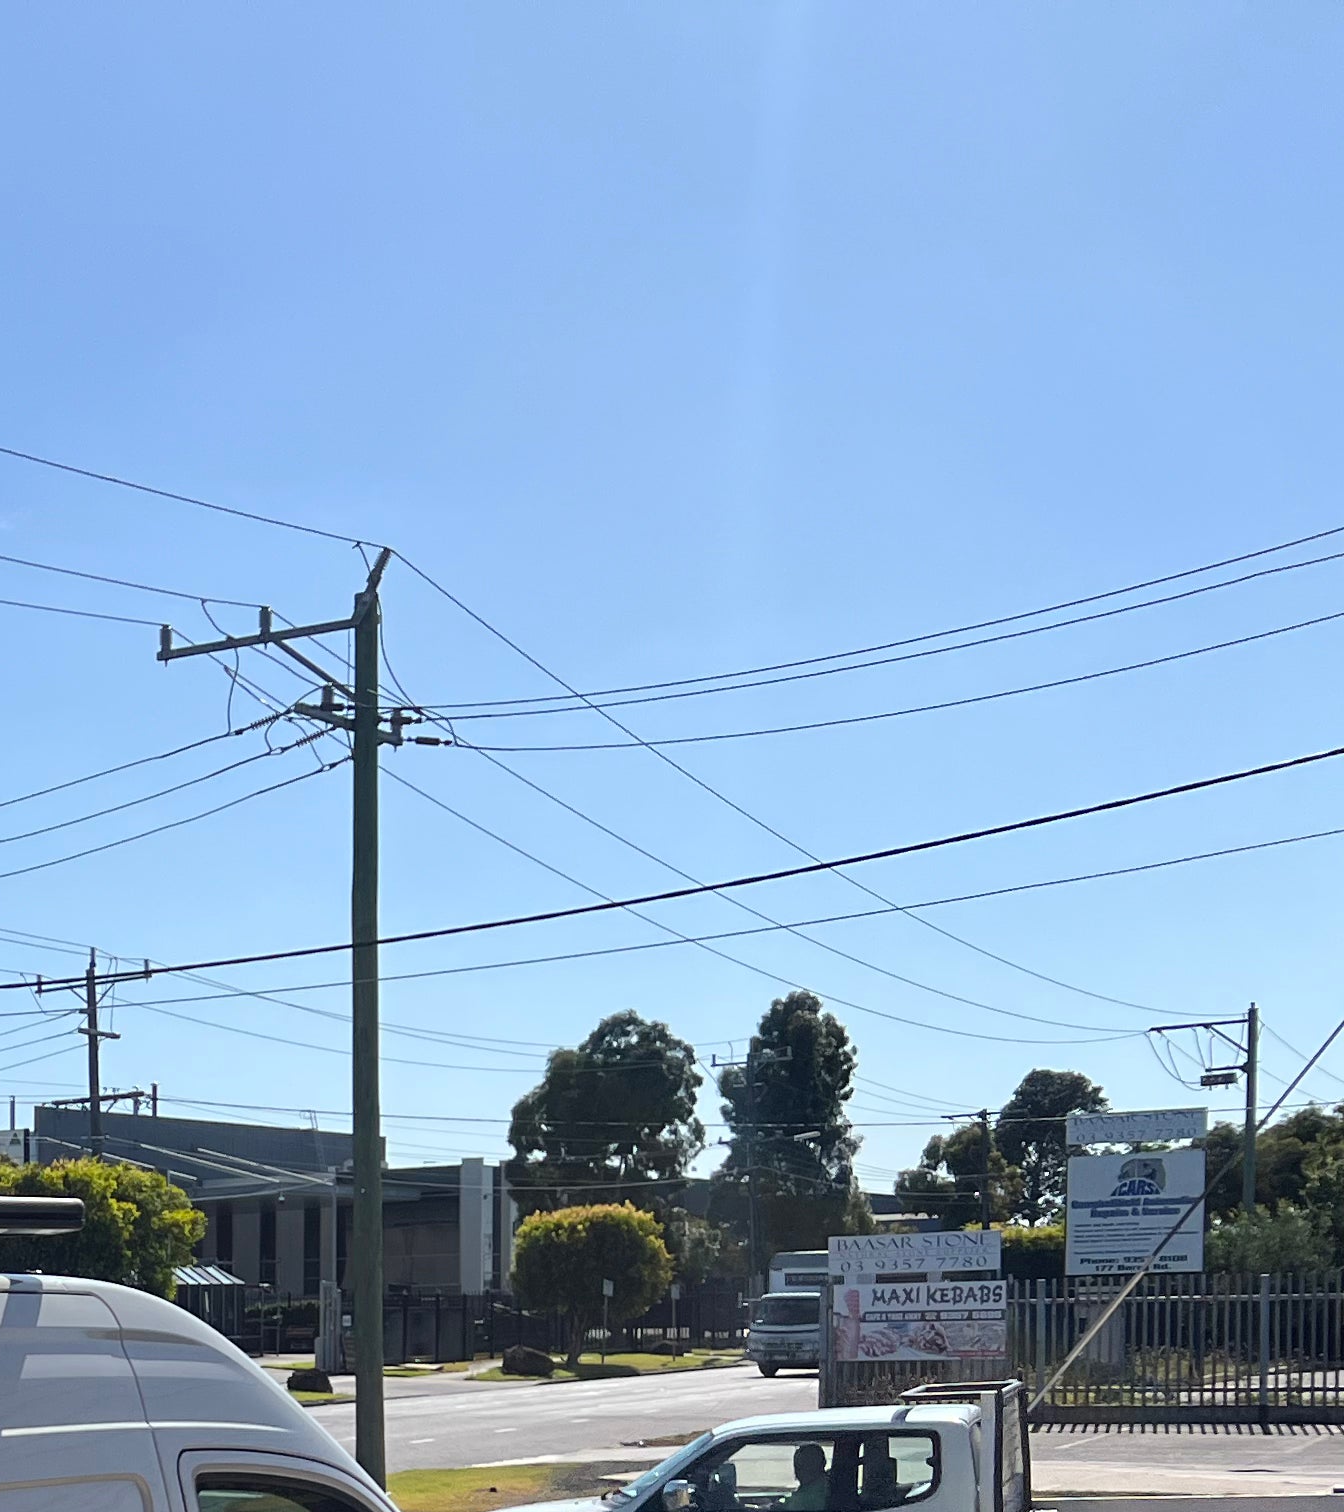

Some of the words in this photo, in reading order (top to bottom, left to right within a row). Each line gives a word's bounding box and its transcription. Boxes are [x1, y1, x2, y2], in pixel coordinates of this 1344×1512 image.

[1076, 1133, 1096, 1142] 03
[837, 1235, 914, 1252] BAASAR
[921, 1232, 987, 1248] STONE
[840, 1260, 864, 1273] 03
[874, 1258, 926, 1270] 9357
[936, 1255, 988, 1268] 7780
[871, 1285, 921, 1307] MAXI
[926, 1284, 1004, 1307] KEBABS
